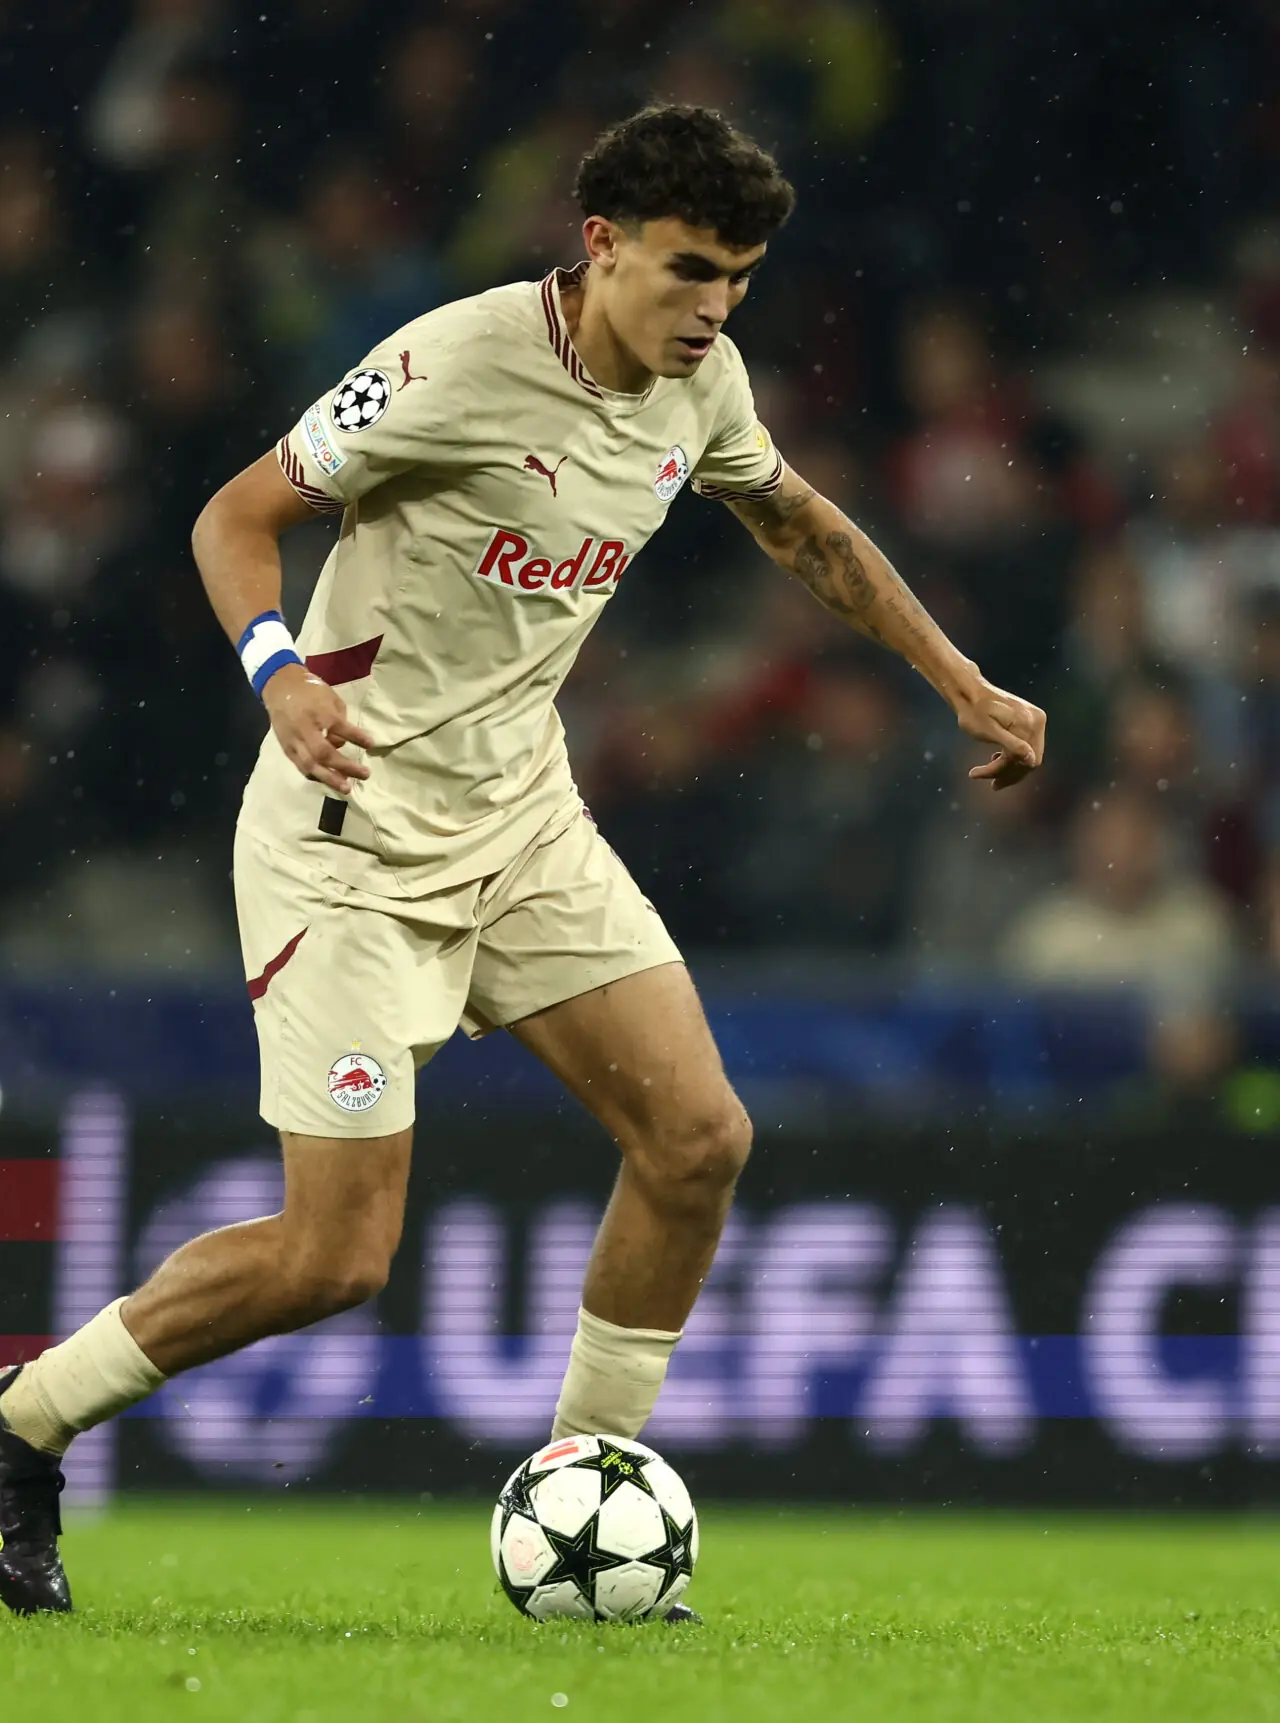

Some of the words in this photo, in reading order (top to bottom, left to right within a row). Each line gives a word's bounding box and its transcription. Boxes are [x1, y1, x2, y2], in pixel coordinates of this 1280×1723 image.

[477, 529, 593, 590] Red
[350, 1057, 362, 1066] FC
[337, 1090, 376, 1108] SALZBURG
